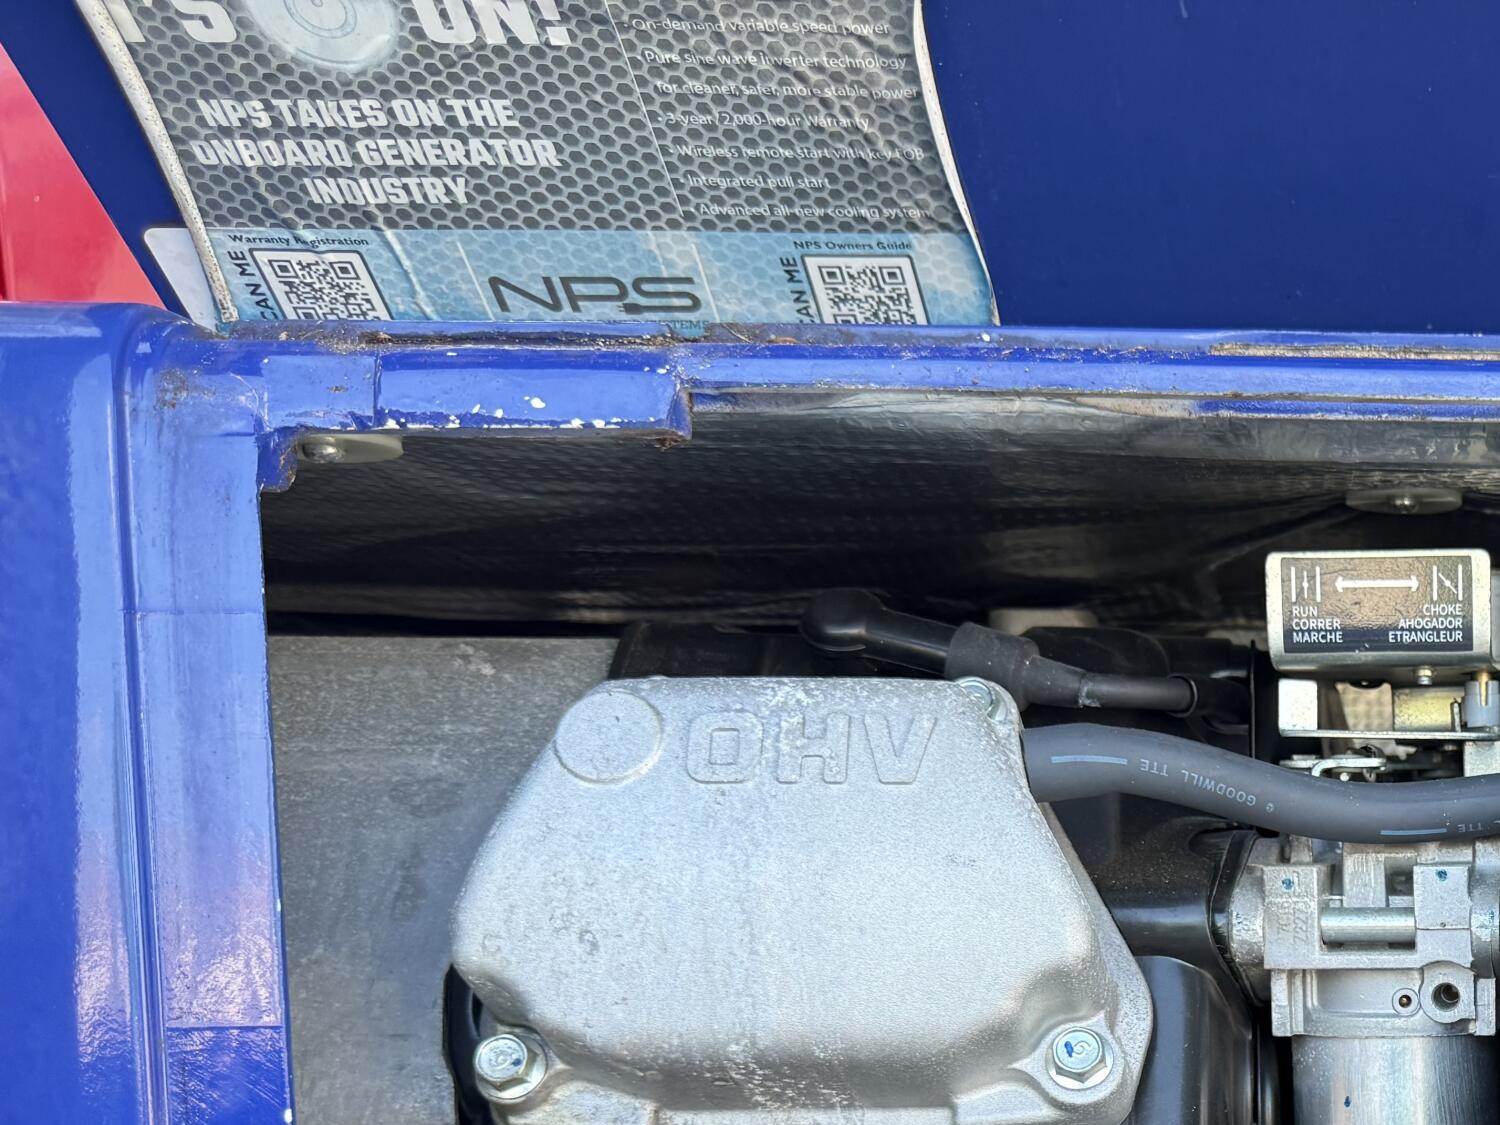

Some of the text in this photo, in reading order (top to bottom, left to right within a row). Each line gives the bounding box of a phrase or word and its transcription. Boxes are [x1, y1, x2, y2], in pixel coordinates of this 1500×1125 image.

[632, 18, 889, 36] On-demand variable speed power
[645, 50, 907, 71] Pure sine wave inverter technology
[656, 81, 918, 101] for cleaner, safer, more stable power
[196, 99, 520, 129] NPS TAKES ON THE
[805, 114, 870, 133] Warranty
[189, 139, 563, 168] ONBOARD GENERATOR
[677, 144, 739, 158] Wireless
[743, 147, 794, 159] remote
[798, 147, 830, 159] start
[833, 147, 863, 160] with
[869, 148, 892, 163] key
[302, 177, 469, 206] INDUSTRY
[688, 174, 831, 190] Integrated pull start
[700, 203, 930, 220] Advanced all-new cooling system
[228, 234, 370, 248] Warranty Registration
[793, 240, 912, 251] NPS Owners Guide
[228, 250, 256, 277] ME
[780, 256, 804, 283] ME
[487, 275, 702, 316] NPS
[1292, 605, 1318, 617] RUN
[1423, 604, 1463, 616] CHOKE
[1292, 618, 1341, 630] CORRER
[1398, 618, 1463, 630] AHOGADOR
[1293, 632, 1343, 643] MARCHE
[1388, 631, 1463, 643] ETRANGLEUR
[685, 709, 938, 785] OHV
[1140, 758, 1257, 806] GOODWILL TTE
